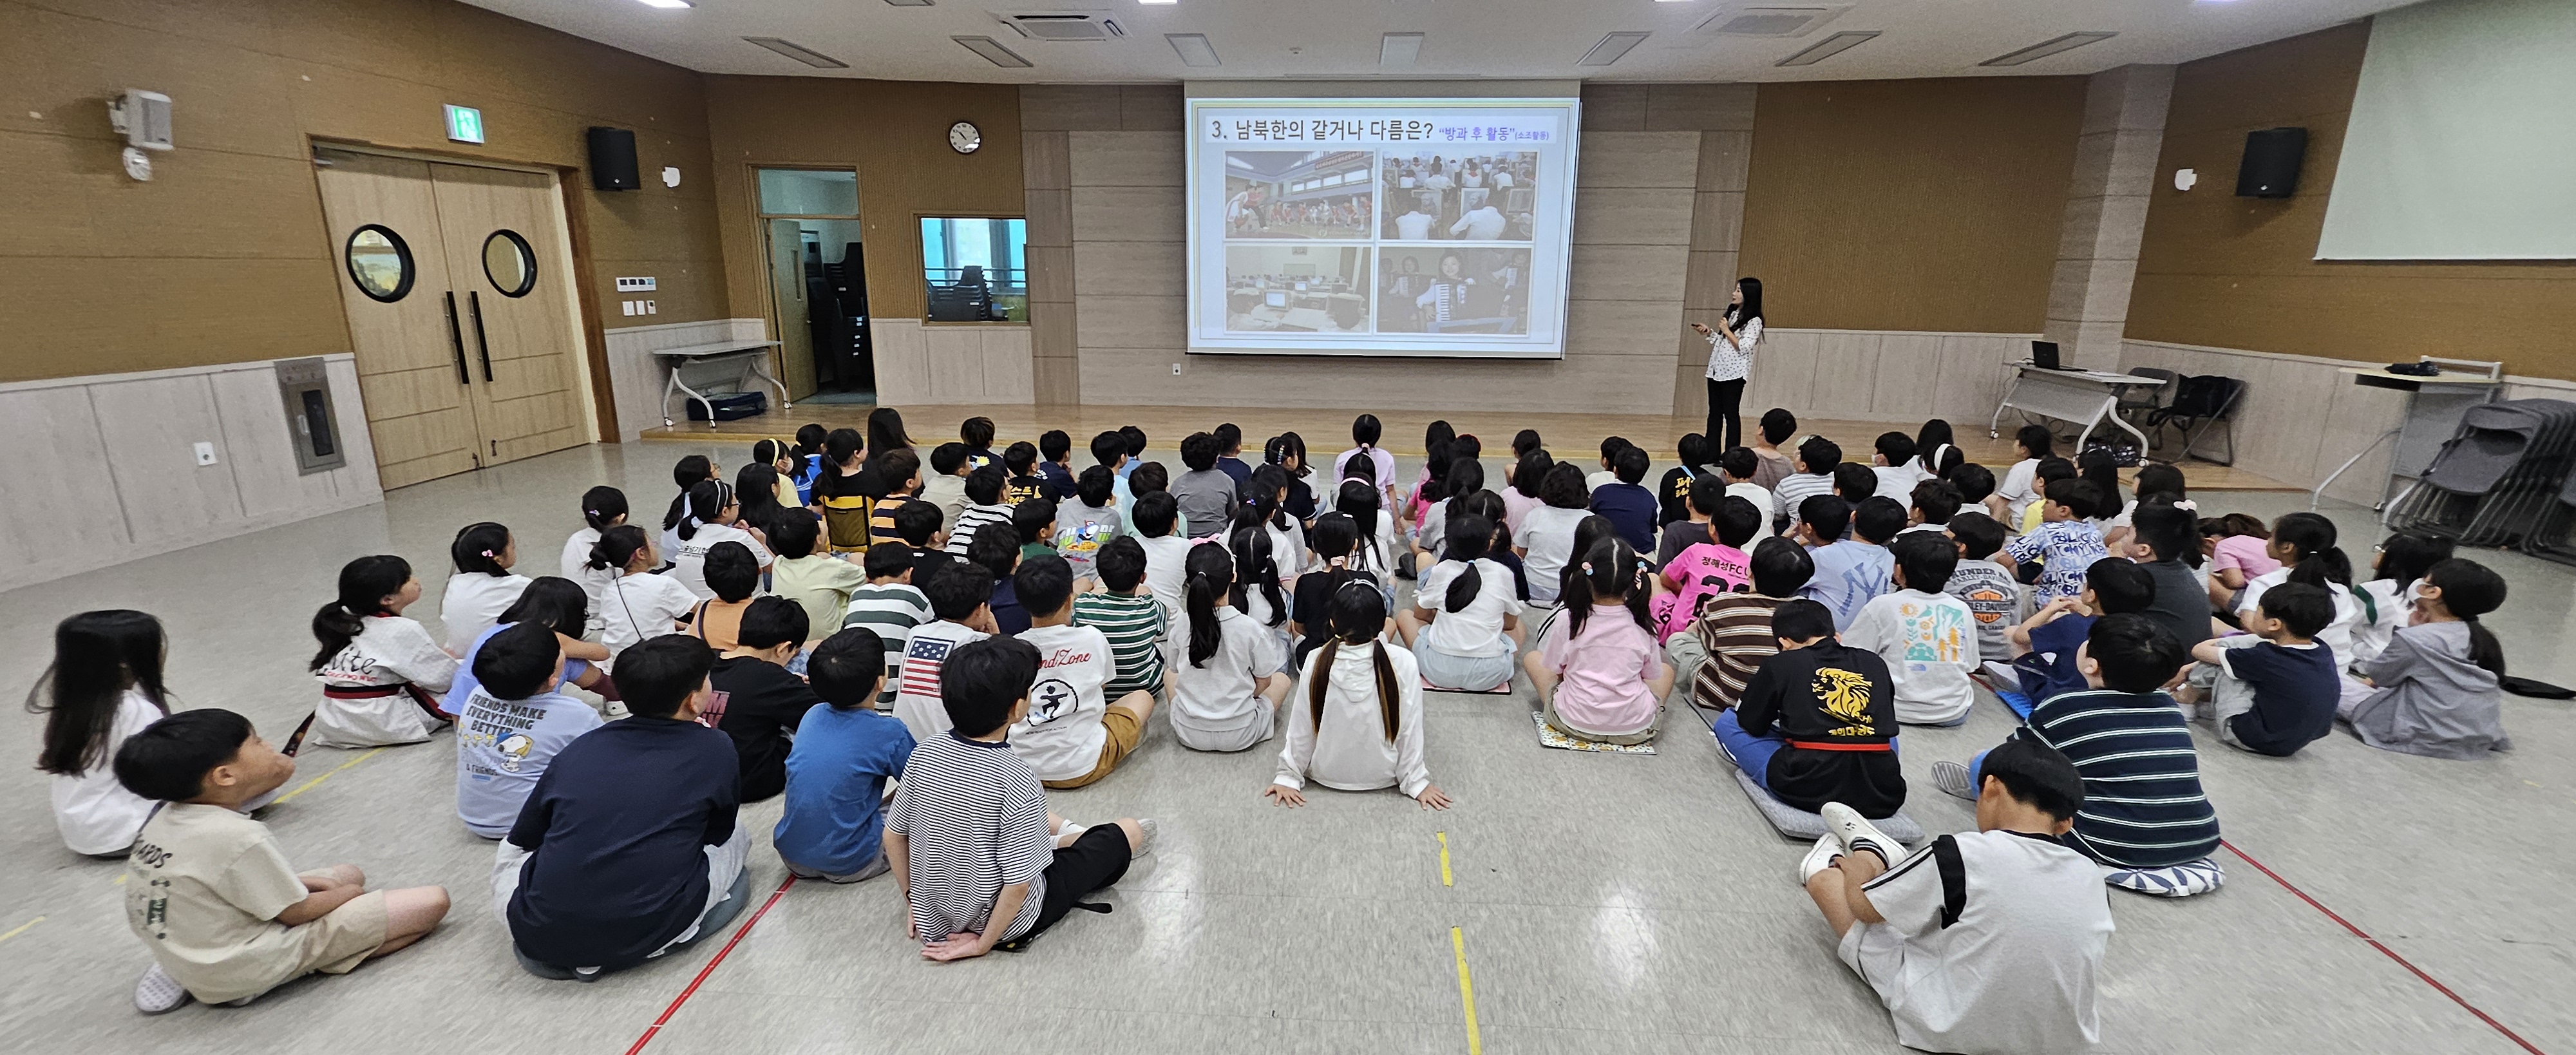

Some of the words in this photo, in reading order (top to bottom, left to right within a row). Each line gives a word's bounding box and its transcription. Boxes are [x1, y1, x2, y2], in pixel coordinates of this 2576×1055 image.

[1211, 120, 1227, 139] 3.
[1236, 120, 1303, 140] 남북한의
[1311, 120, 1363, 140] 같거나
[1370, 120, 1434, 140] 다름은?
[1439, 127, 1468, 141] “방과
[1471, 127, 1482, 141] 후
[1701, 556, 1743, 575] 정해성FC
[466, 705, 535, 730] EVERYTHING
[469, 694, 509, 713] FRIENDS
[509, 704, 547, 720] MAKE
